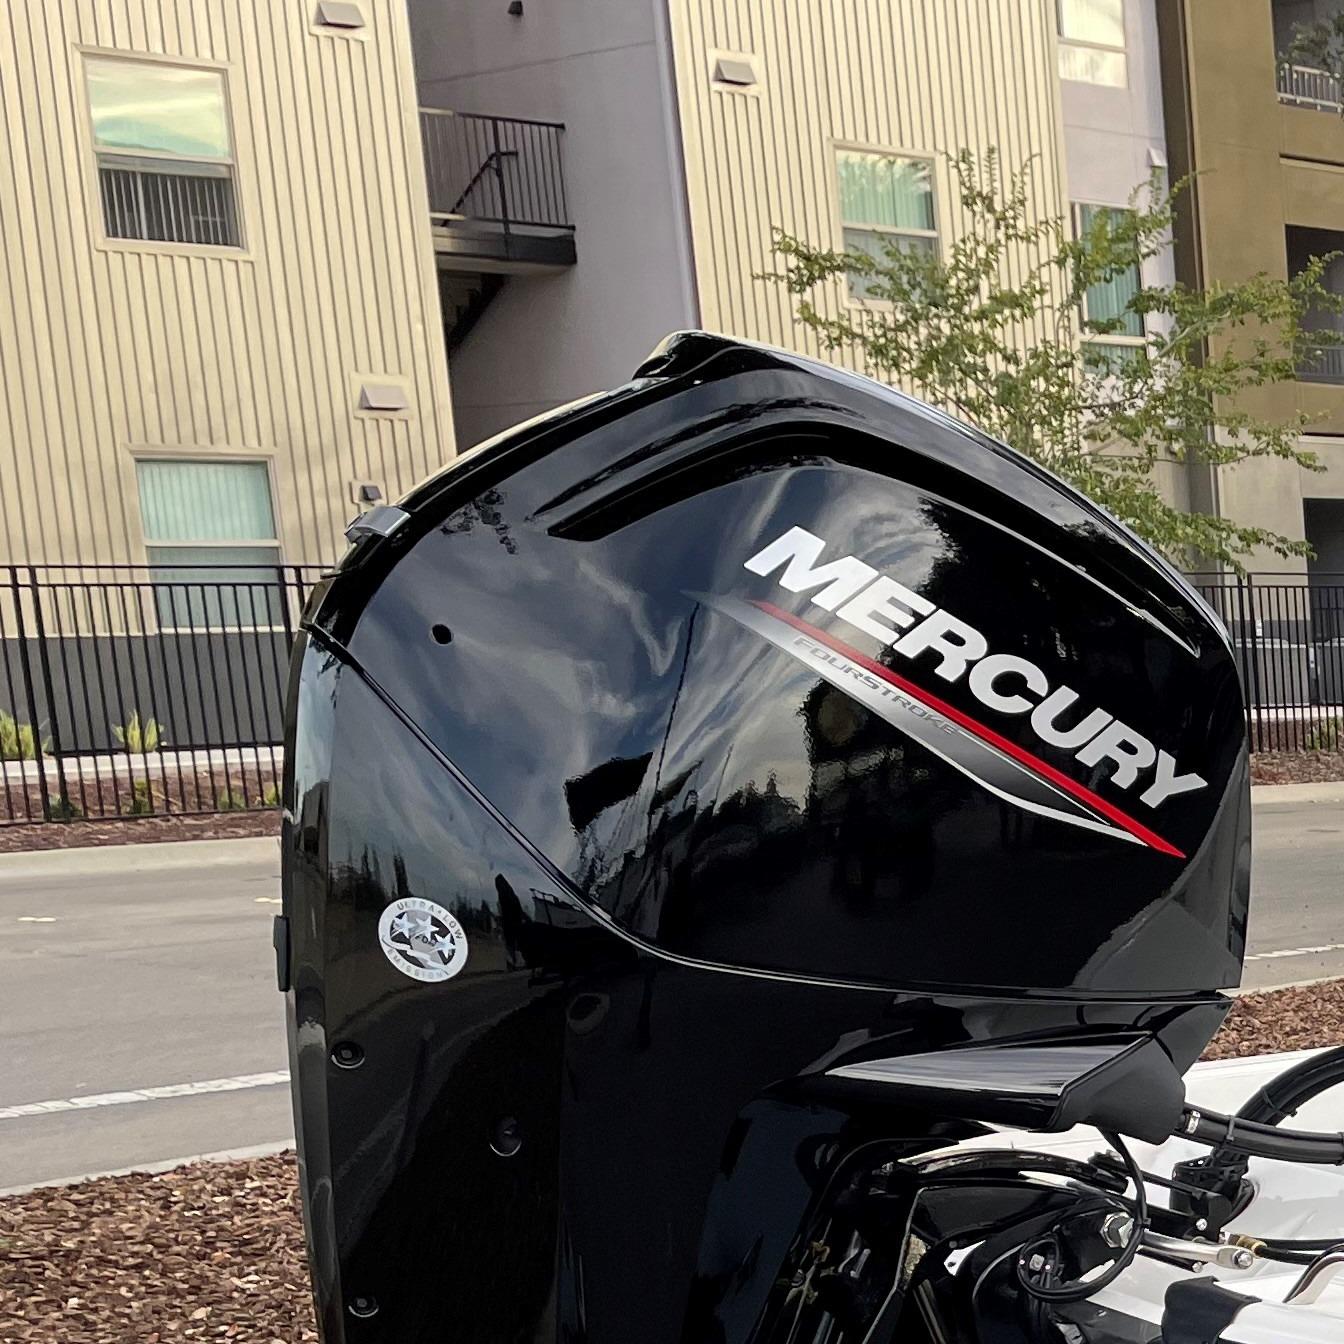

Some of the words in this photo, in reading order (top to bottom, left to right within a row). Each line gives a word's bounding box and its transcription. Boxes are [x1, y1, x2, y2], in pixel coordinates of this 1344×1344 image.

[743, 525, 1208, 809] MERCURY
[793, 637, 958, 734] FOURSTROKE
[397, 901, 434, 913] ULTRA
[443, 914, 464, 939] LOW
